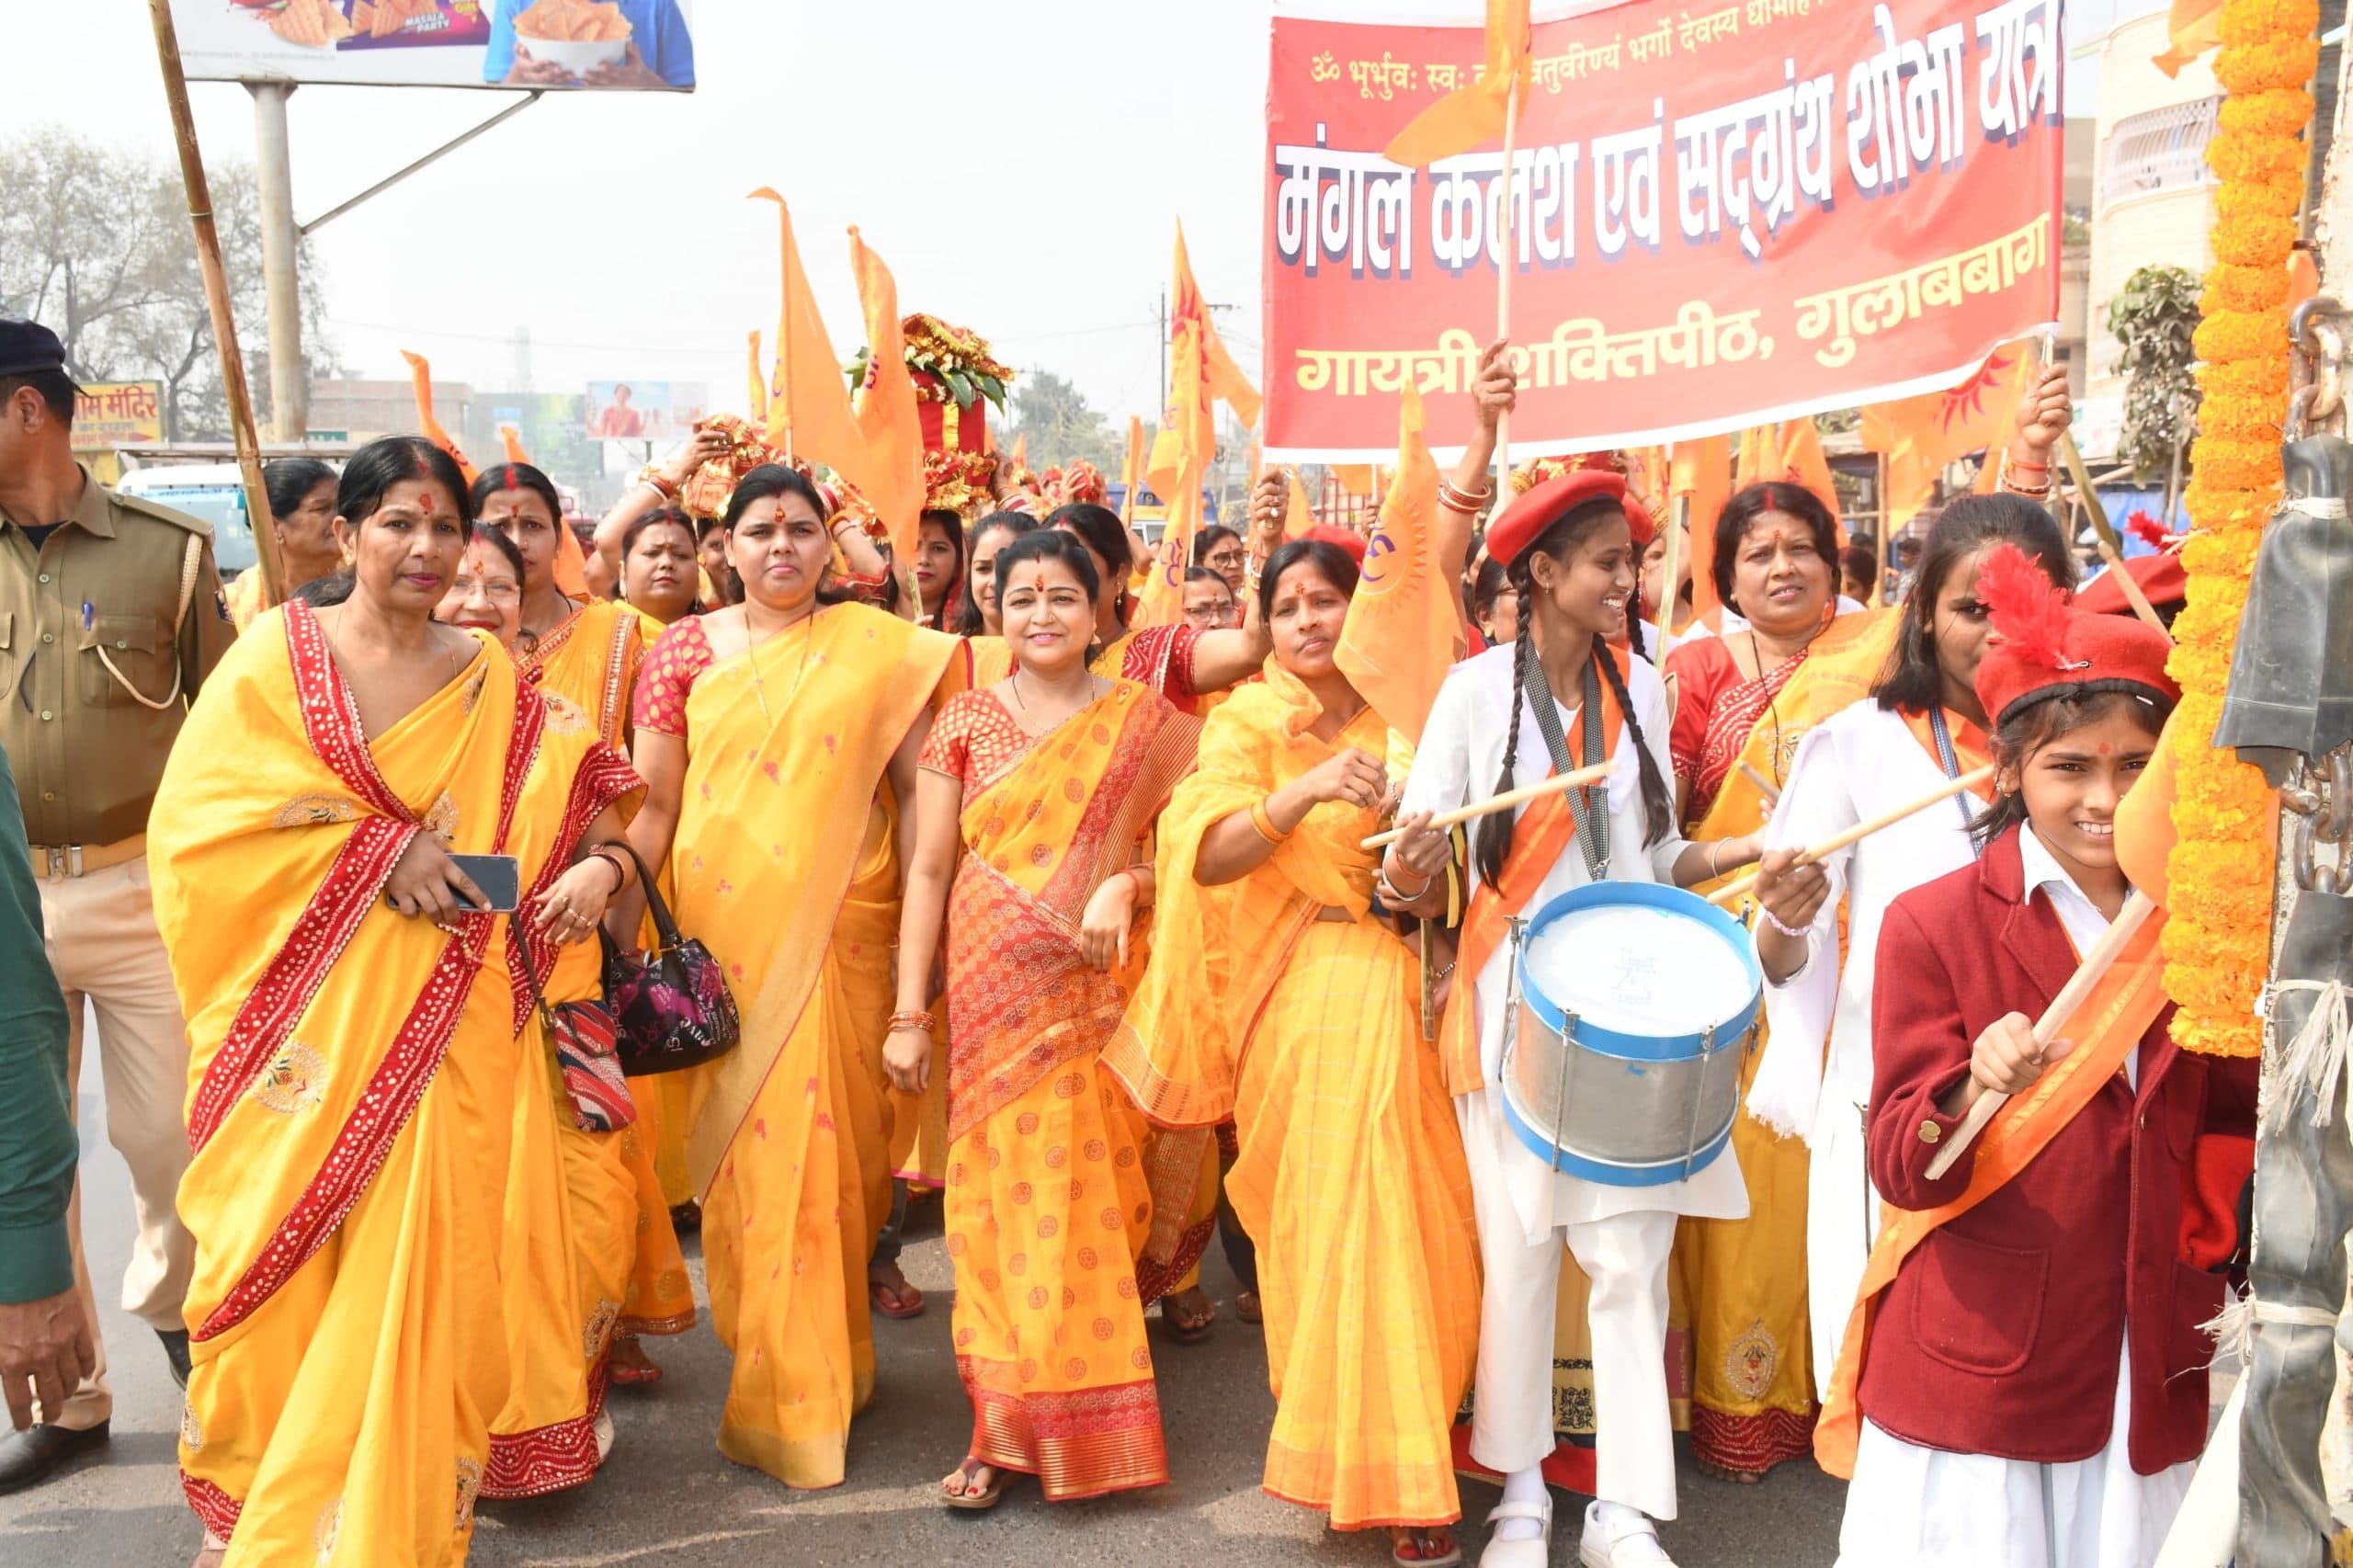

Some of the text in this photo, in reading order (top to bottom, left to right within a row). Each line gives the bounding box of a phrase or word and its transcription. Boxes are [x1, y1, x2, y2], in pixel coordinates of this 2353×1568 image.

[404, 12, 445, 28] MASALA
[417, 18, 449, 34] PARTY
[1311, 50, 1341, 82] ॐ
[1677, 7, 1740, 52] देवस्य
[1275, 121, 1416, 278] मंगल
[1428, 142, 1579, 278] कलश
[1592, 97, 1663, 262] एवं
[1847, 3, 1964, 198] शोभा
[1296, 328, 1482, 396] गायत्री
[1793, 212, 2051, 368] गुलाबबाग
[106, 384, 158, 422] मंदिर
